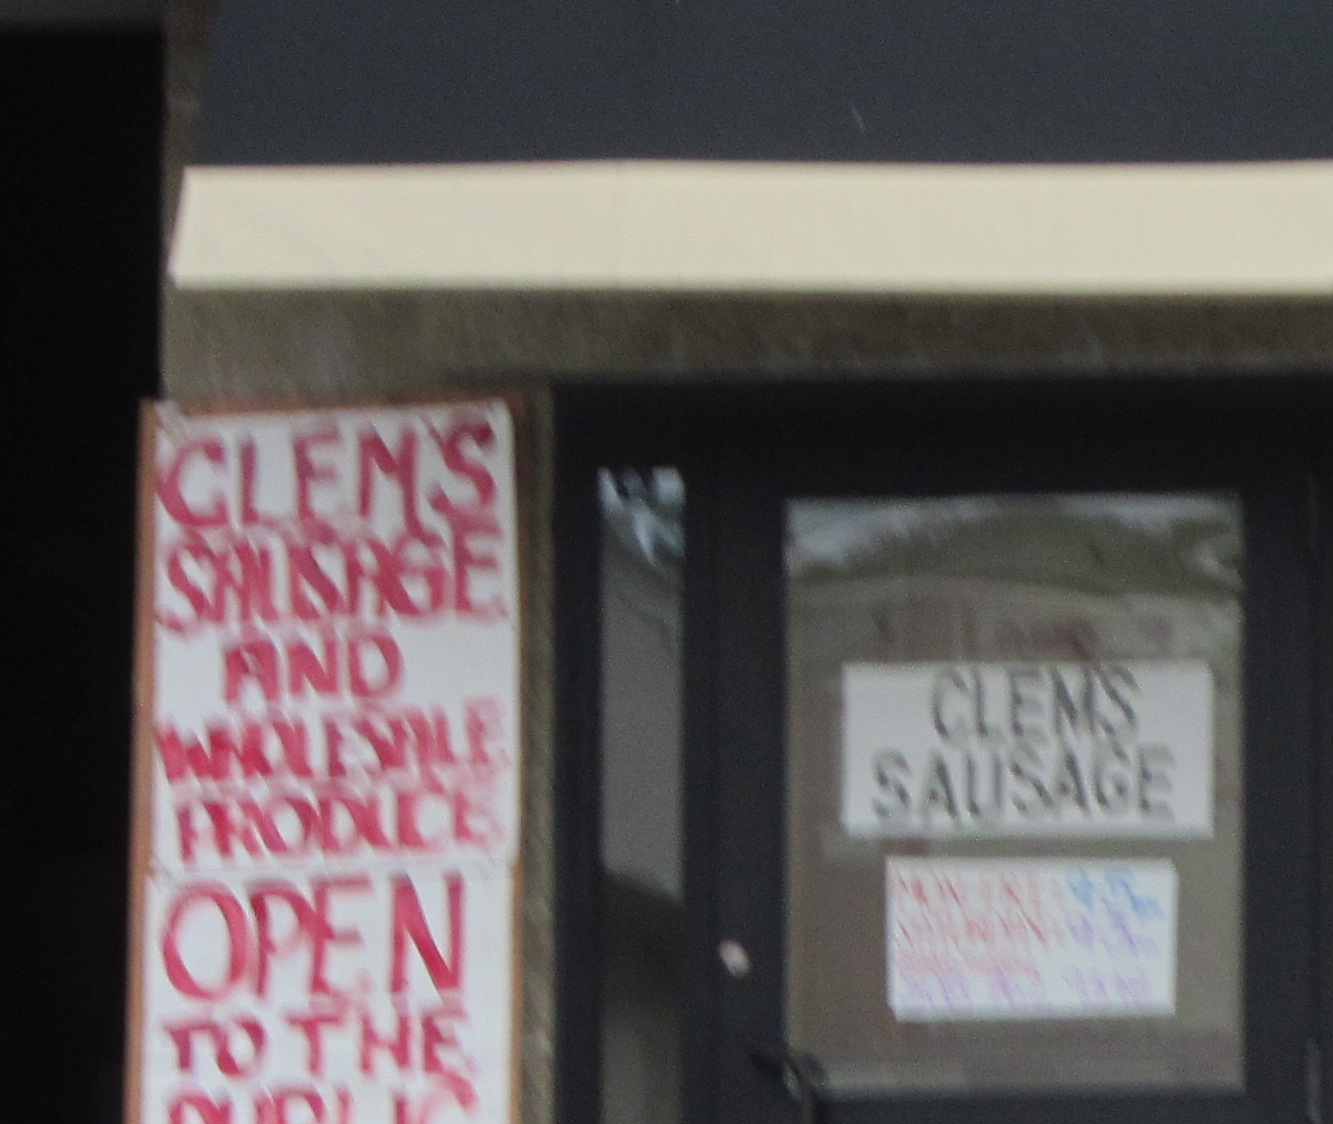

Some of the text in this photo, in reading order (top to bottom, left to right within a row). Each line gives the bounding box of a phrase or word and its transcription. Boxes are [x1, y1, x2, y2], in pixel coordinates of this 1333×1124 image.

[156, 414, 500, 532] CLEMS
[223, 634, 404, 702] AND
[930, 666, 1140, 742] CLEMS
[872, 742, 1176, 826] SAUSAGE
[161, 872, 466, 1002] OPEN
[162, 1004, 474, 1078] TO THE
